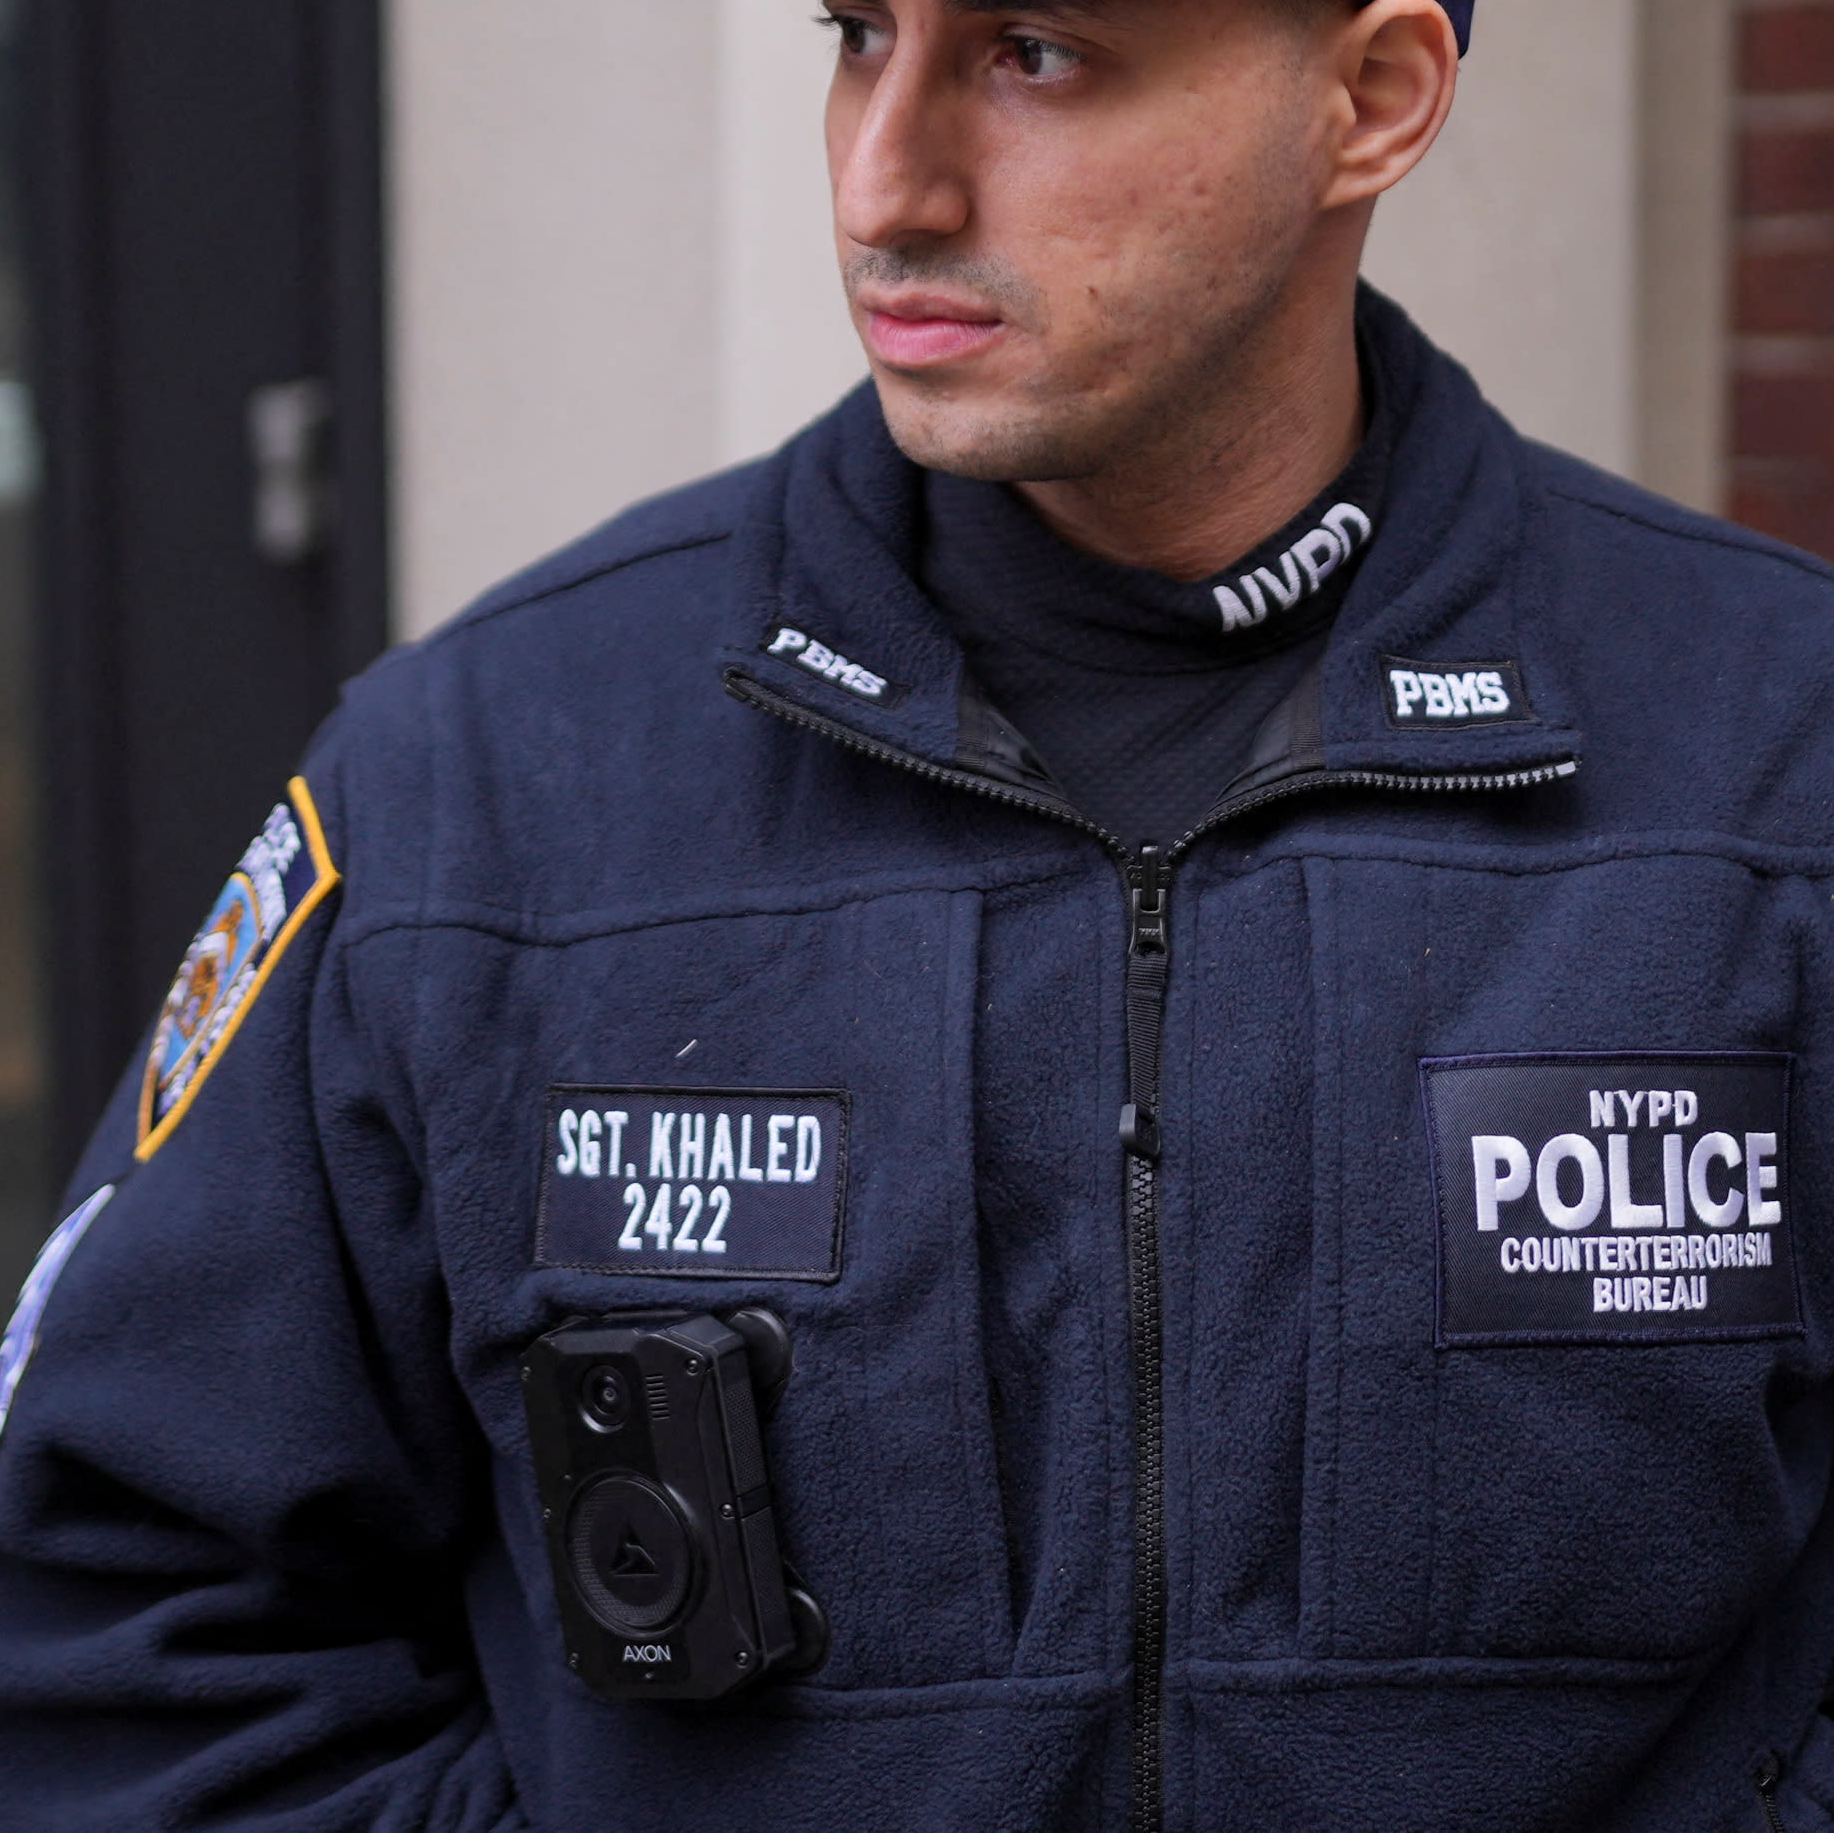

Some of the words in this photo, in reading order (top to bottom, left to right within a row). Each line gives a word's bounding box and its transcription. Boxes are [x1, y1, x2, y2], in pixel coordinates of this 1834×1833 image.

[767, 627, 887, 697] PBMS
[1389, 670, 1511, 719] PBMS
[1588, 1089, 1699, 1128] NYPD
[556, 1108, 638, 1180] SGT.
[648, 1110, 822, 1184] KHALED
[1470, 1130, 1782, 1232] POLICE
[617, 1182, 732, 1254] 2422
[1499, 1231, 1773, 1274] COUNTERTERRORISM
[1592, 1274, 1708, 1313] BUREAU
[623, 1644, 672, 1662] AXON
